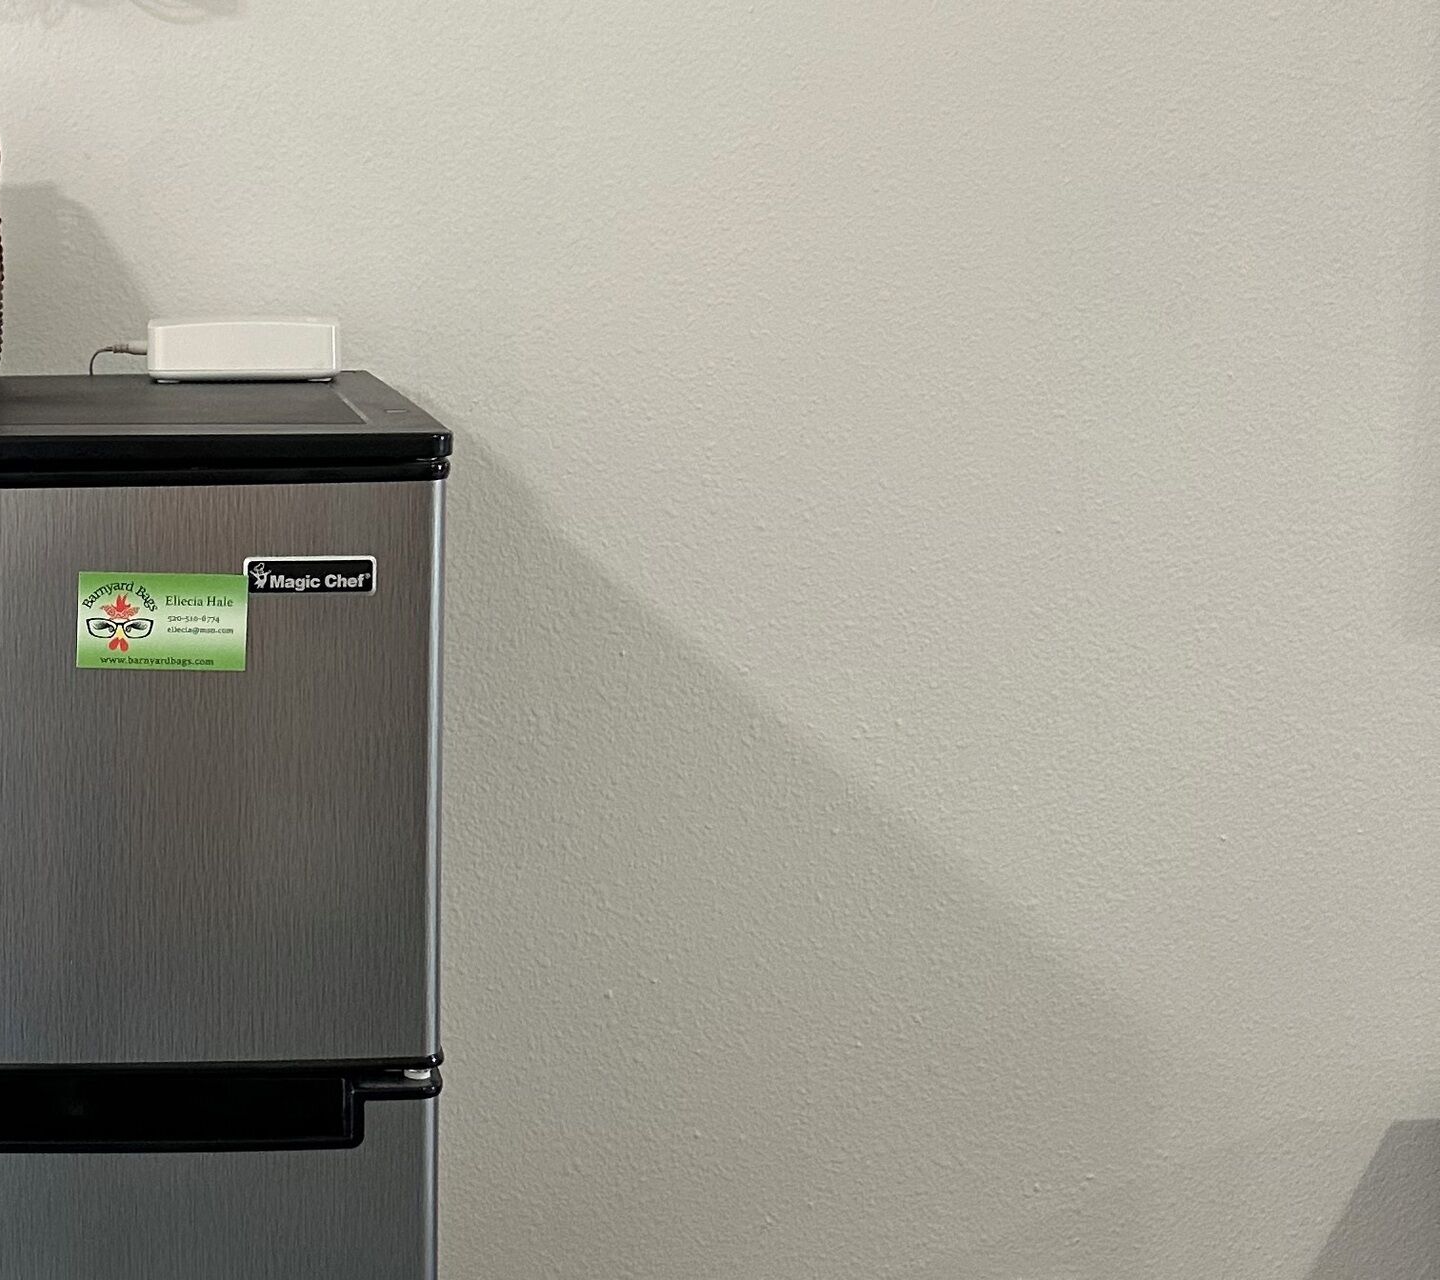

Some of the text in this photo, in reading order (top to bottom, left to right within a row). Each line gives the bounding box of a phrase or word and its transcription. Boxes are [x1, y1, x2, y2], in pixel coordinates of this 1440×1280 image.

[269, 574, 321, 592] Magic
[81, 580, 159, 612] Barnyard Bags
[165, 594, 204, 607] Eliecia
[100, 655, 215, 667] www.barnyardbags.com
